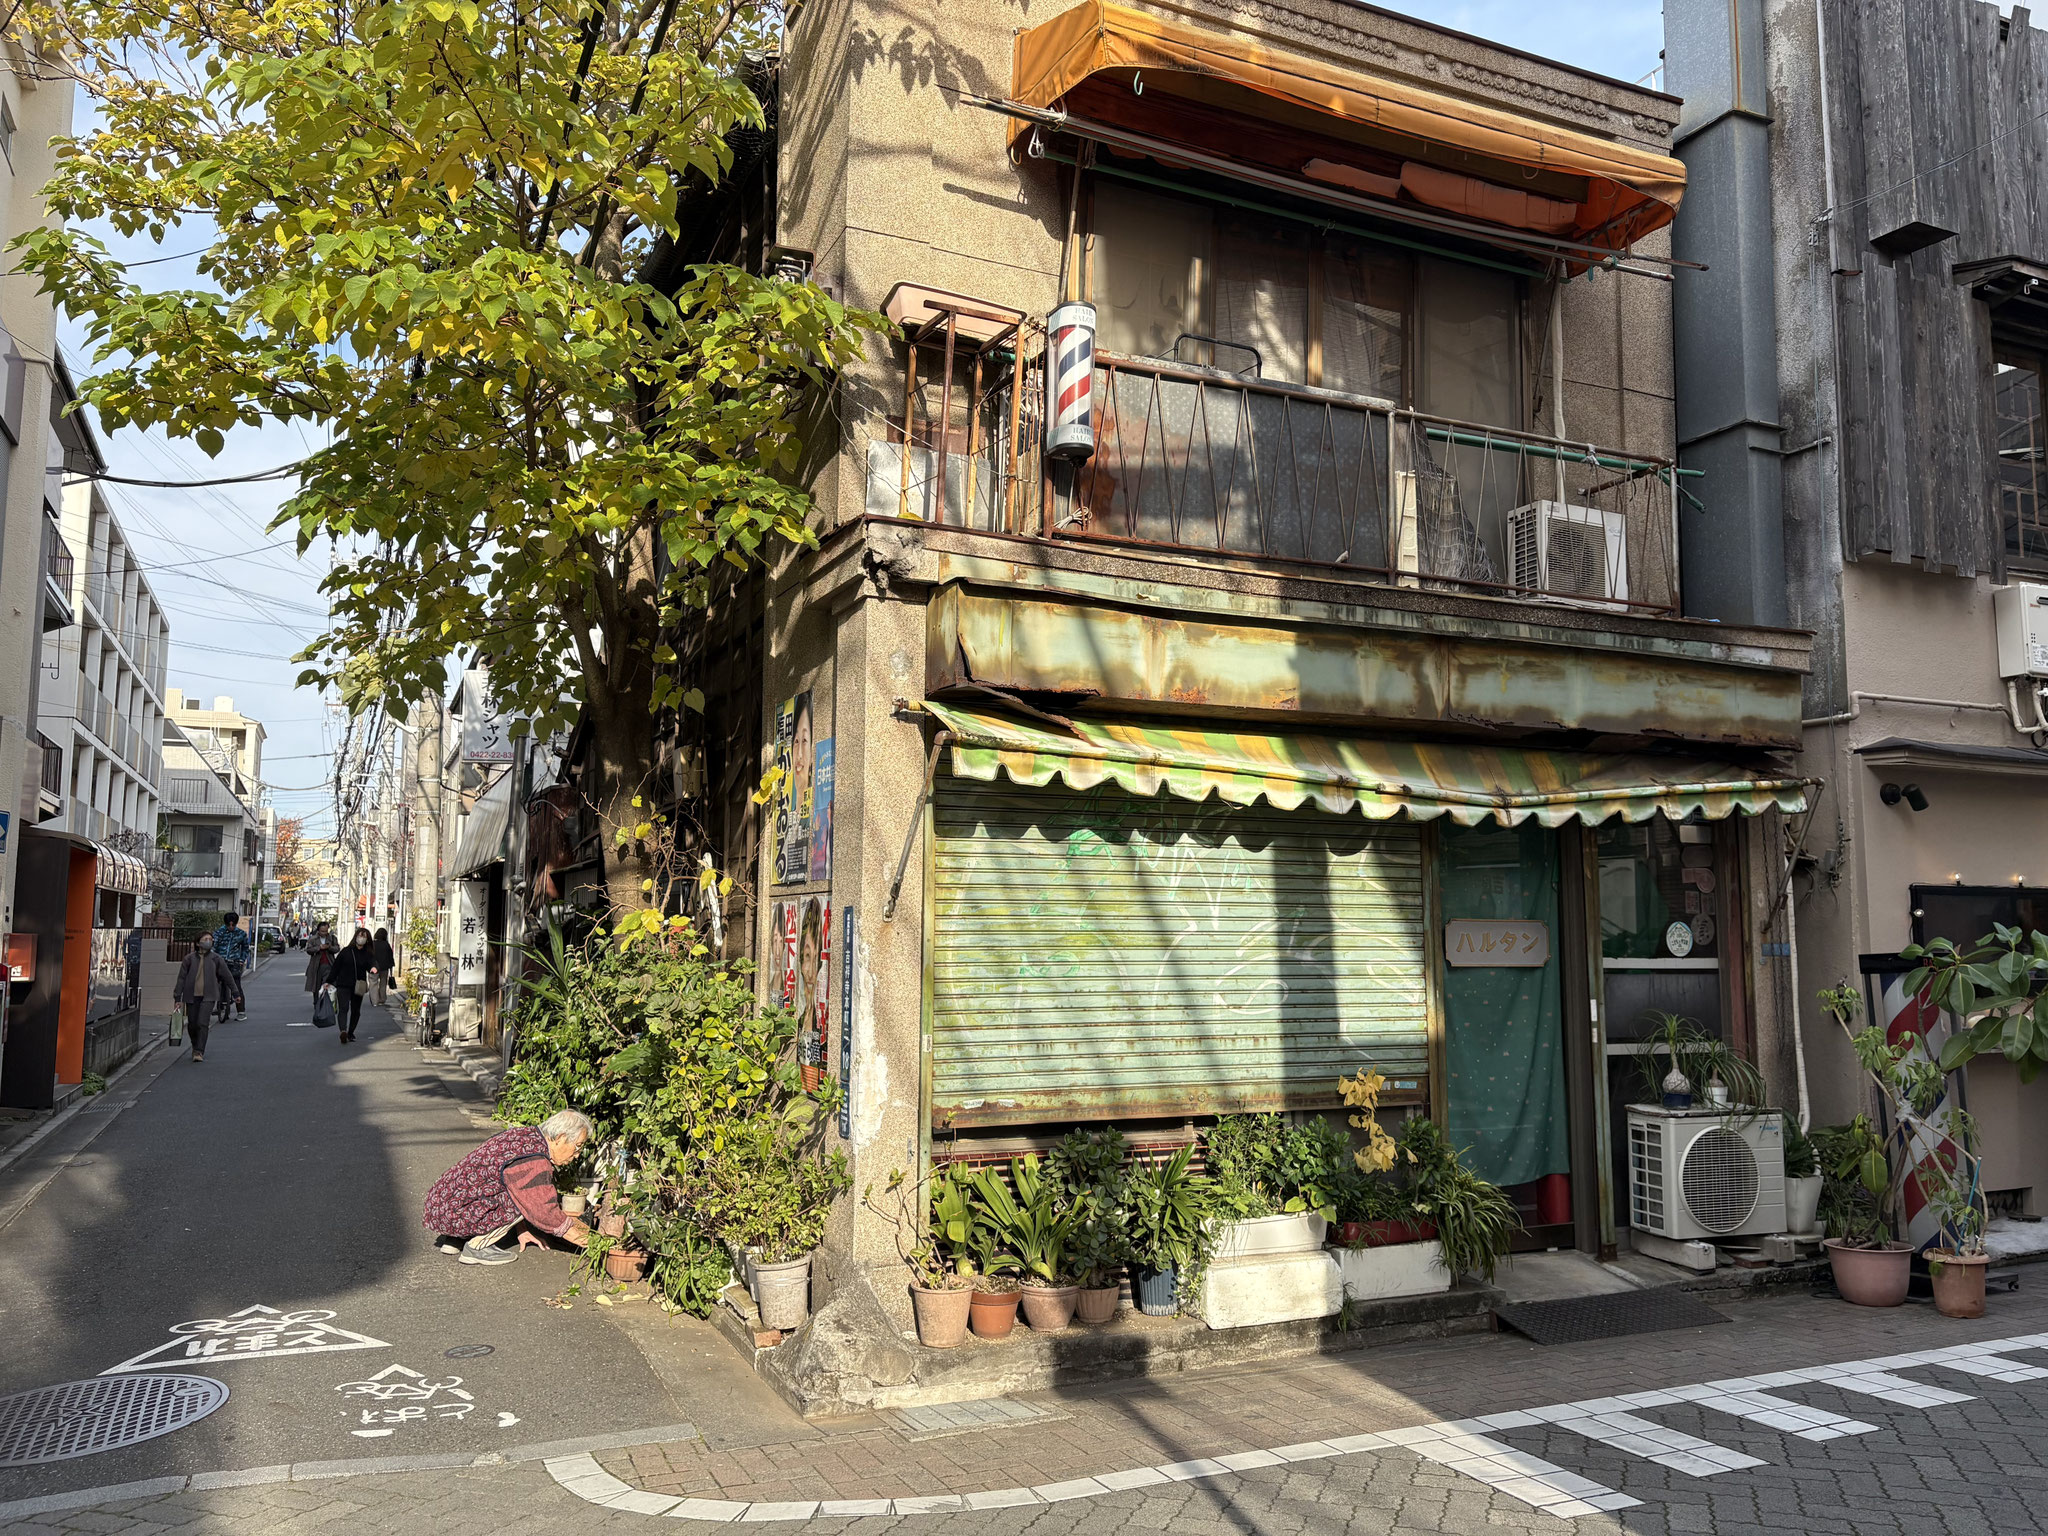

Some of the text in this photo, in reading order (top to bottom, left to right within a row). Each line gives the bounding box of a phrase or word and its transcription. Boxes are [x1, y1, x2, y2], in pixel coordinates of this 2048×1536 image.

[1074, 307, 1093, 317] HAIR
[1072, 314, 1094, 324] SALON
[1072, 426, 1091, 435] HAIR
[1070, 434, 1092, 443] SALON
[470, 751, 515, 759] 0422-22-83
[476, 887, 487, 965] オーダーワイシャツ専門
[461, 917, 476, 971] 若林
[1456, 931, 1539, 954] ハルタン
[185, 1330, 327, 1356] とまれ
